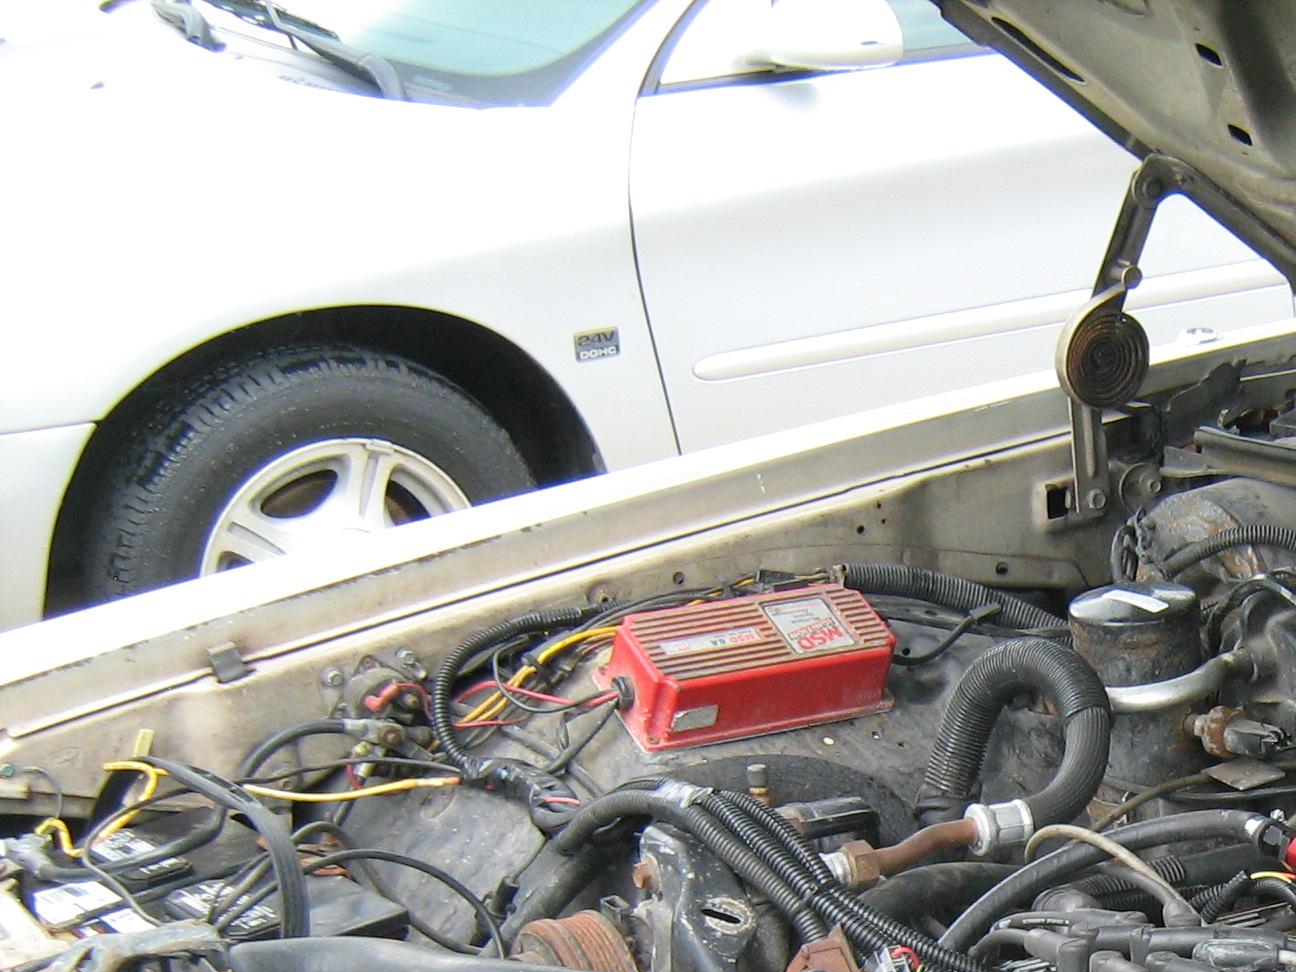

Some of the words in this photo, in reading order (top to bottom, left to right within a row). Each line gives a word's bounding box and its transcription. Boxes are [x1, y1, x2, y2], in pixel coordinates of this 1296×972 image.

[578, 331, 615, 347] 24V
[580, 346, 617, 360] DOHC
[797, 625, 845, 651] MSD
